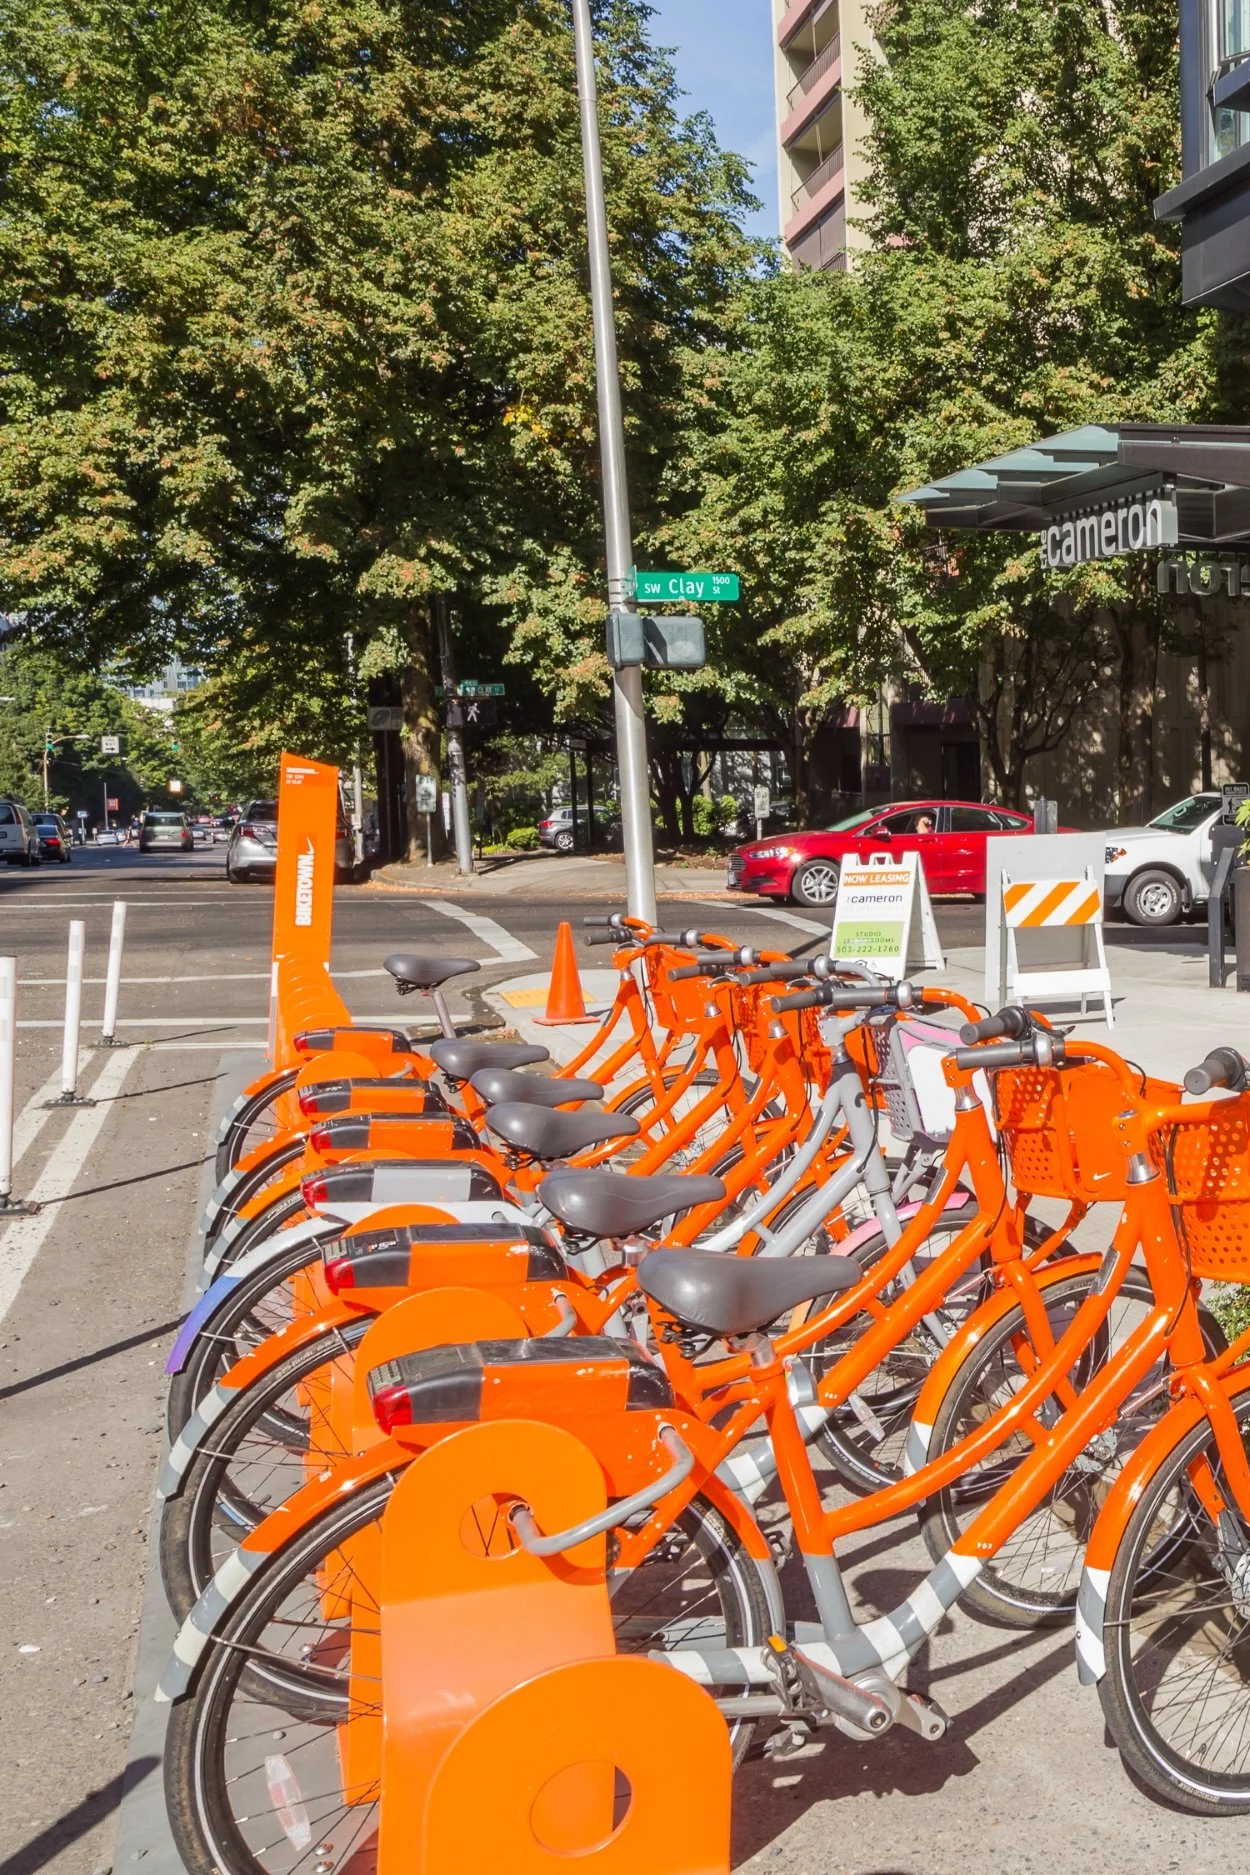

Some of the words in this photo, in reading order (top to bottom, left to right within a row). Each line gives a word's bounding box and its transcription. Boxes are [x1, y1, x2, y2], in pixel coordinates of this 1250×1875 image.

[1047, 499, 1163, 567] cameron
[712, 576, 730, 585] 1500
[644, 583, 660, 594] SW
[669, 578, 704, 598] Clay
[712, 586, 720, 594] St
[844, 875, 868, 884] NOW
[870, 873, 909, 883] LEASING
[295, 854, 314, 926] BIKETOWN
[852, 894, 902, 904] cameron
[836, 945, 899, 953] 503-222-1760
